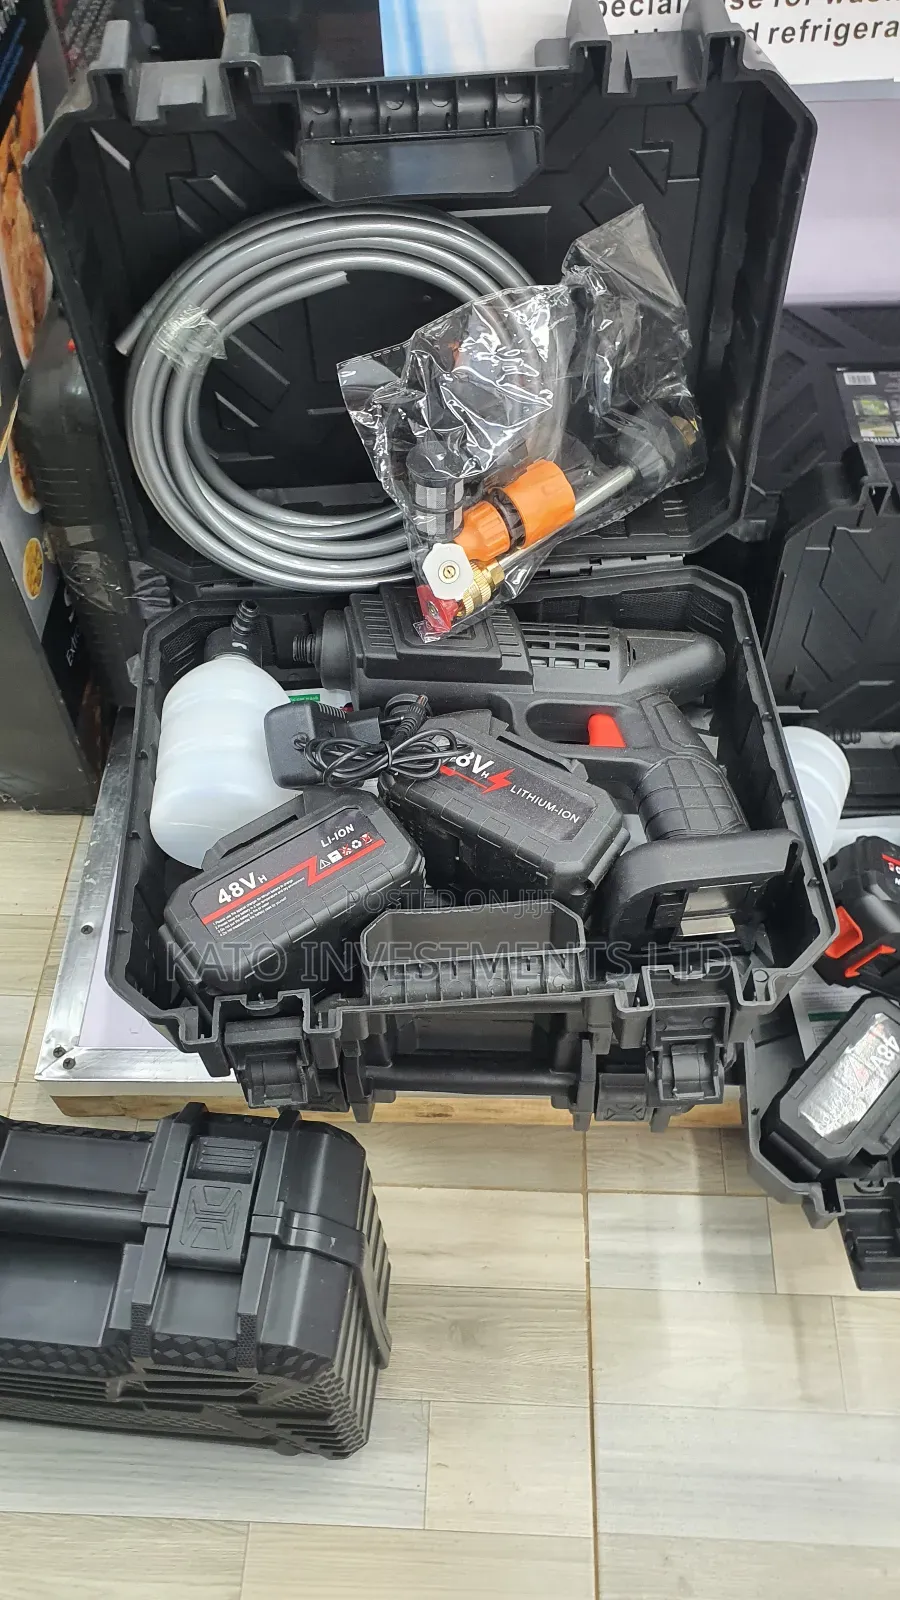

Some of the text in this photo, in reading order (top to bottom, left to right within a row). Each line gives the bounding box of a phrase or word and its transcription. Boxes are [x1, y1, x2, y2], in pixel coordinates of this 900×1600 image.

[768, 18, 899, 47] refrigera
[509, 784, 580, 824] LITHIUM-ION
[320, 823, 355, 848] LI-ION
